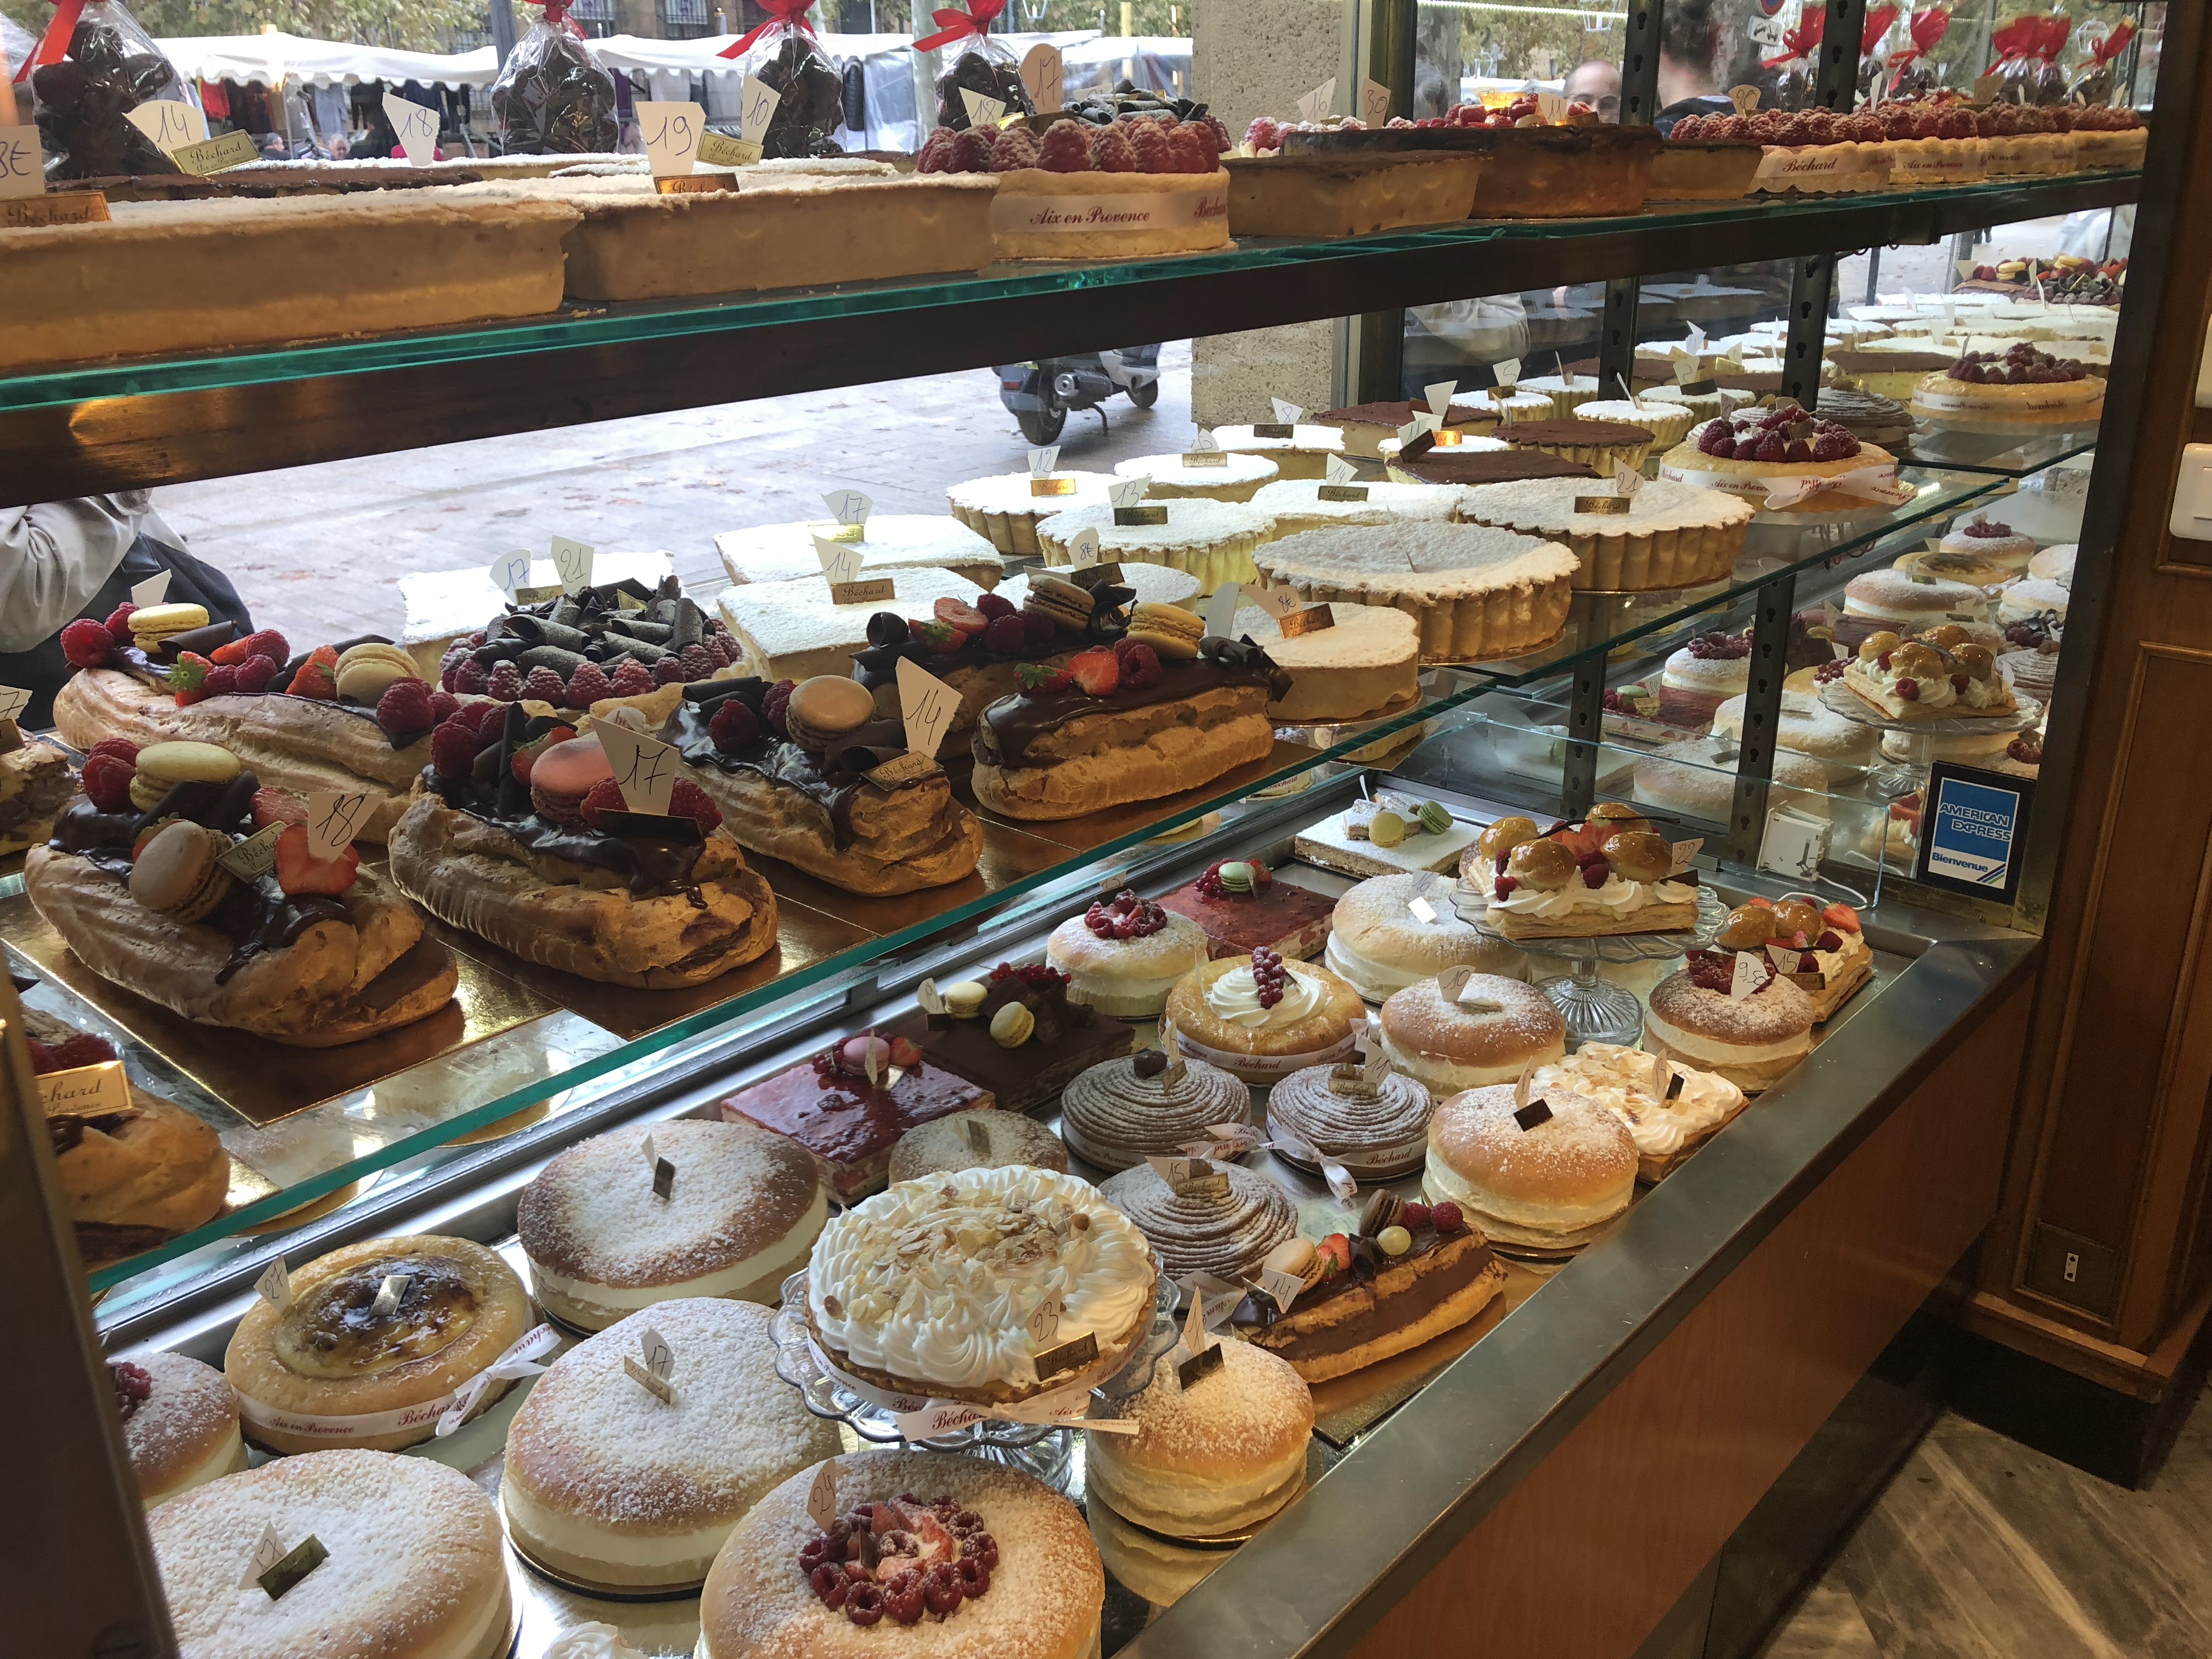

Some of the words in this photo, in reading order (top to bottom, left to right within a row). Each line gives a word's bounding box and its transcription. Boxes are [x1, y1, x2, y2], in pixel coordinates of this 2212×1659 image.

[1035, 54, 1059, 106] 17
[747, 91, 769, 126] 10
[1311, 84, 1328, 117] 16
[1367, 89, 1388, 115] 30
[157, 104, 190, 143] 14
[400, 109, 432, 138] 18
[647, 116, 692, 156] 19
[190, 141, 241, 163] Béchard
[710, 139, 752, 160] Béchard
[1782, 158, 1837, 172] Béchard
[1030, 207, 1061, 224] Aix
[1064, 213, 1082, 224] en
[1086, 205, 1150, 223] Provence
[1503, 363, 1517, 385] 5
[1282, 405, 1293, 423] 8
[1034, 449, 1053, 472] 12
[1189, 455, 1221, 464] Béchard
[1327, 465, 1345, 484] 14
[1617, 471, 1637, 493] 21
[1711, 479, 1728, 489] Aix
[1112, 481, 1139, 507] 13
[1327, 489, 1361, 499] Béchard
[1584, 499, 1621, 510] Béchard
[838, 494, 866, 523] 17
[1080, 543, 1094, 560] 8€
[504, 558, 529, 591] 17
[561, 548, 586, 583] 21
[826, 552, 851, 584] 14
[843, 585, 884, 598] Béchard
[1278, 592, 1296, 613] 8€
[0, 691, 25, 718] 7
[906, 689, 941, 746] 14
[619, 744, 668, 795] 17
[879, 758, 923, 778] Béchard
[316, 793, 367, 847] 18
[1939, 803, 2010, 827] AMERICAN
[1951, 819, 2012, 842] EXPRESS
[237, 838, 275, 865] Bécha
[1675, 842, 1695, 865] 22
[1932, 852, 1988, 872] Bienvenue
[1412, 872, 1434, 891] 16
[1777, 952, 1797, 973] 15
[1443, 969, 1470, 990] 10
[1234, 1056, 1282, 1070] Béchard
[1366, 1057, 1389, 1079] 11
[41, 1077, 102, 1104] chard
[1337, 1082, 1369, 1093] Béchard
[1366, 1147, 1412, 1165] Béchard
[1166, 1162, 1185, 1181] 15
[1185, 1179, 1220, 1190] Béchard
[265, 1265, 283, 1299] 27
[1271, 1277, 1290, 1305] 14
[1034, 1301, 1059, 1342] 23
[647, 1345, 670, 1376] 17
[1047, 1341, 1088, 1365] Béchard
[823, 1363, 856, 1391] Provence
[269, 1417, 291, 1430] Aix
[293, 1421, 304, 1431] en
[304, 1420, 354, 1434] Provence
[813, 1472, 835, 1515] 24
